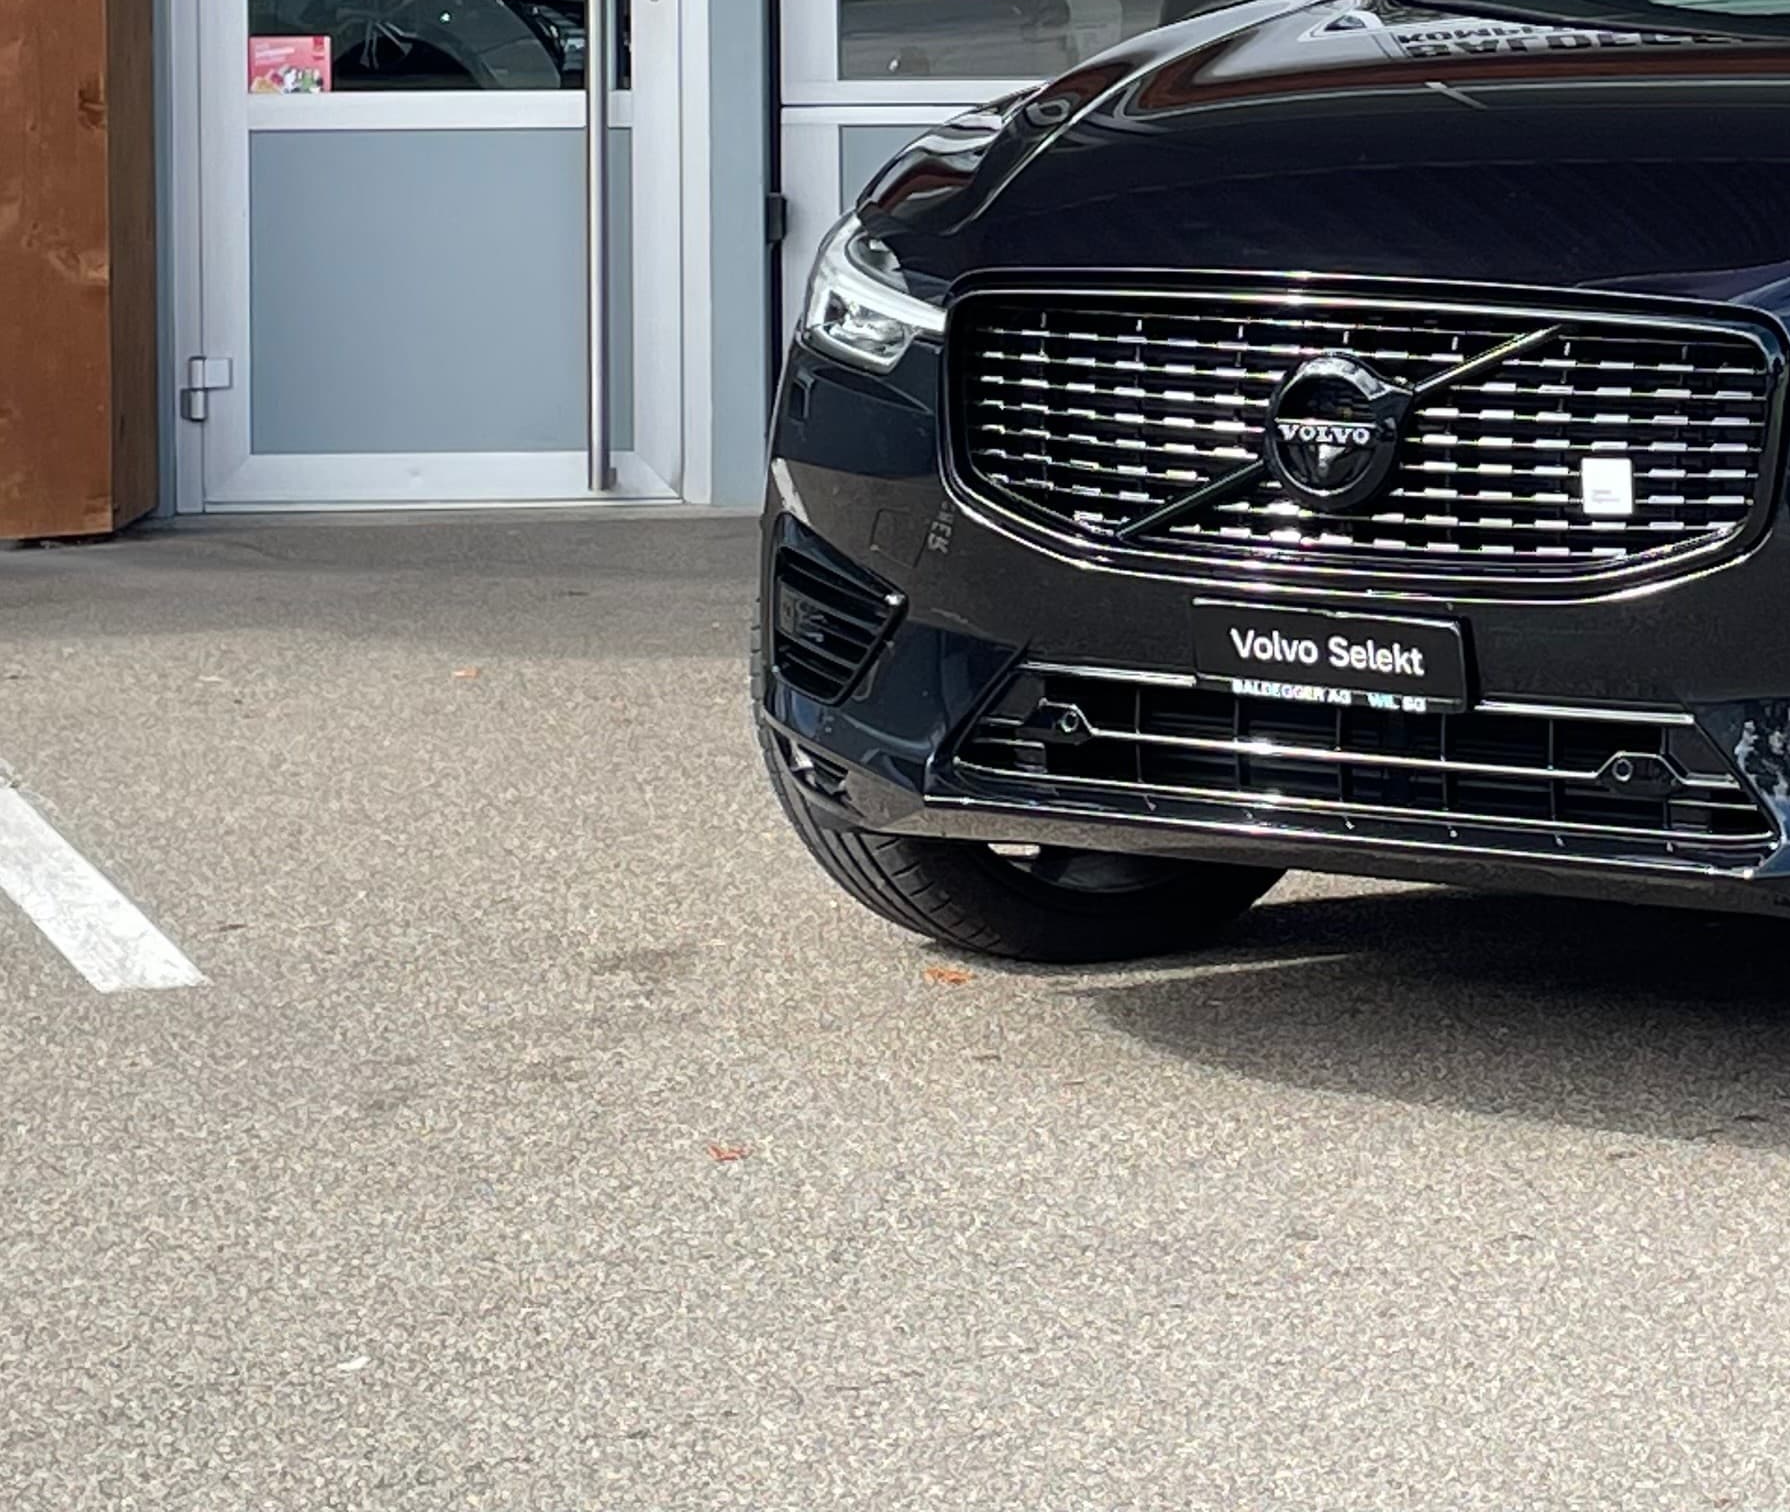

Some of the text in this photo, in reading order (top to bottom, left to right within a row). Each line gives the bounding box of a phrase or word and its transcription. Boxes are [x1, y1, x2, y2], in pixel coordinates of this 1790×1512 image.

[1277, 424, 1371, 446] VOLVO
[1229, 627, 1425, 677] Volvo Selekt
[1231, 677, 1325, 702] BALDEGGER
[1326, 687, 1352, 705] AG
[1366, 691, 1400, 710] WIL
